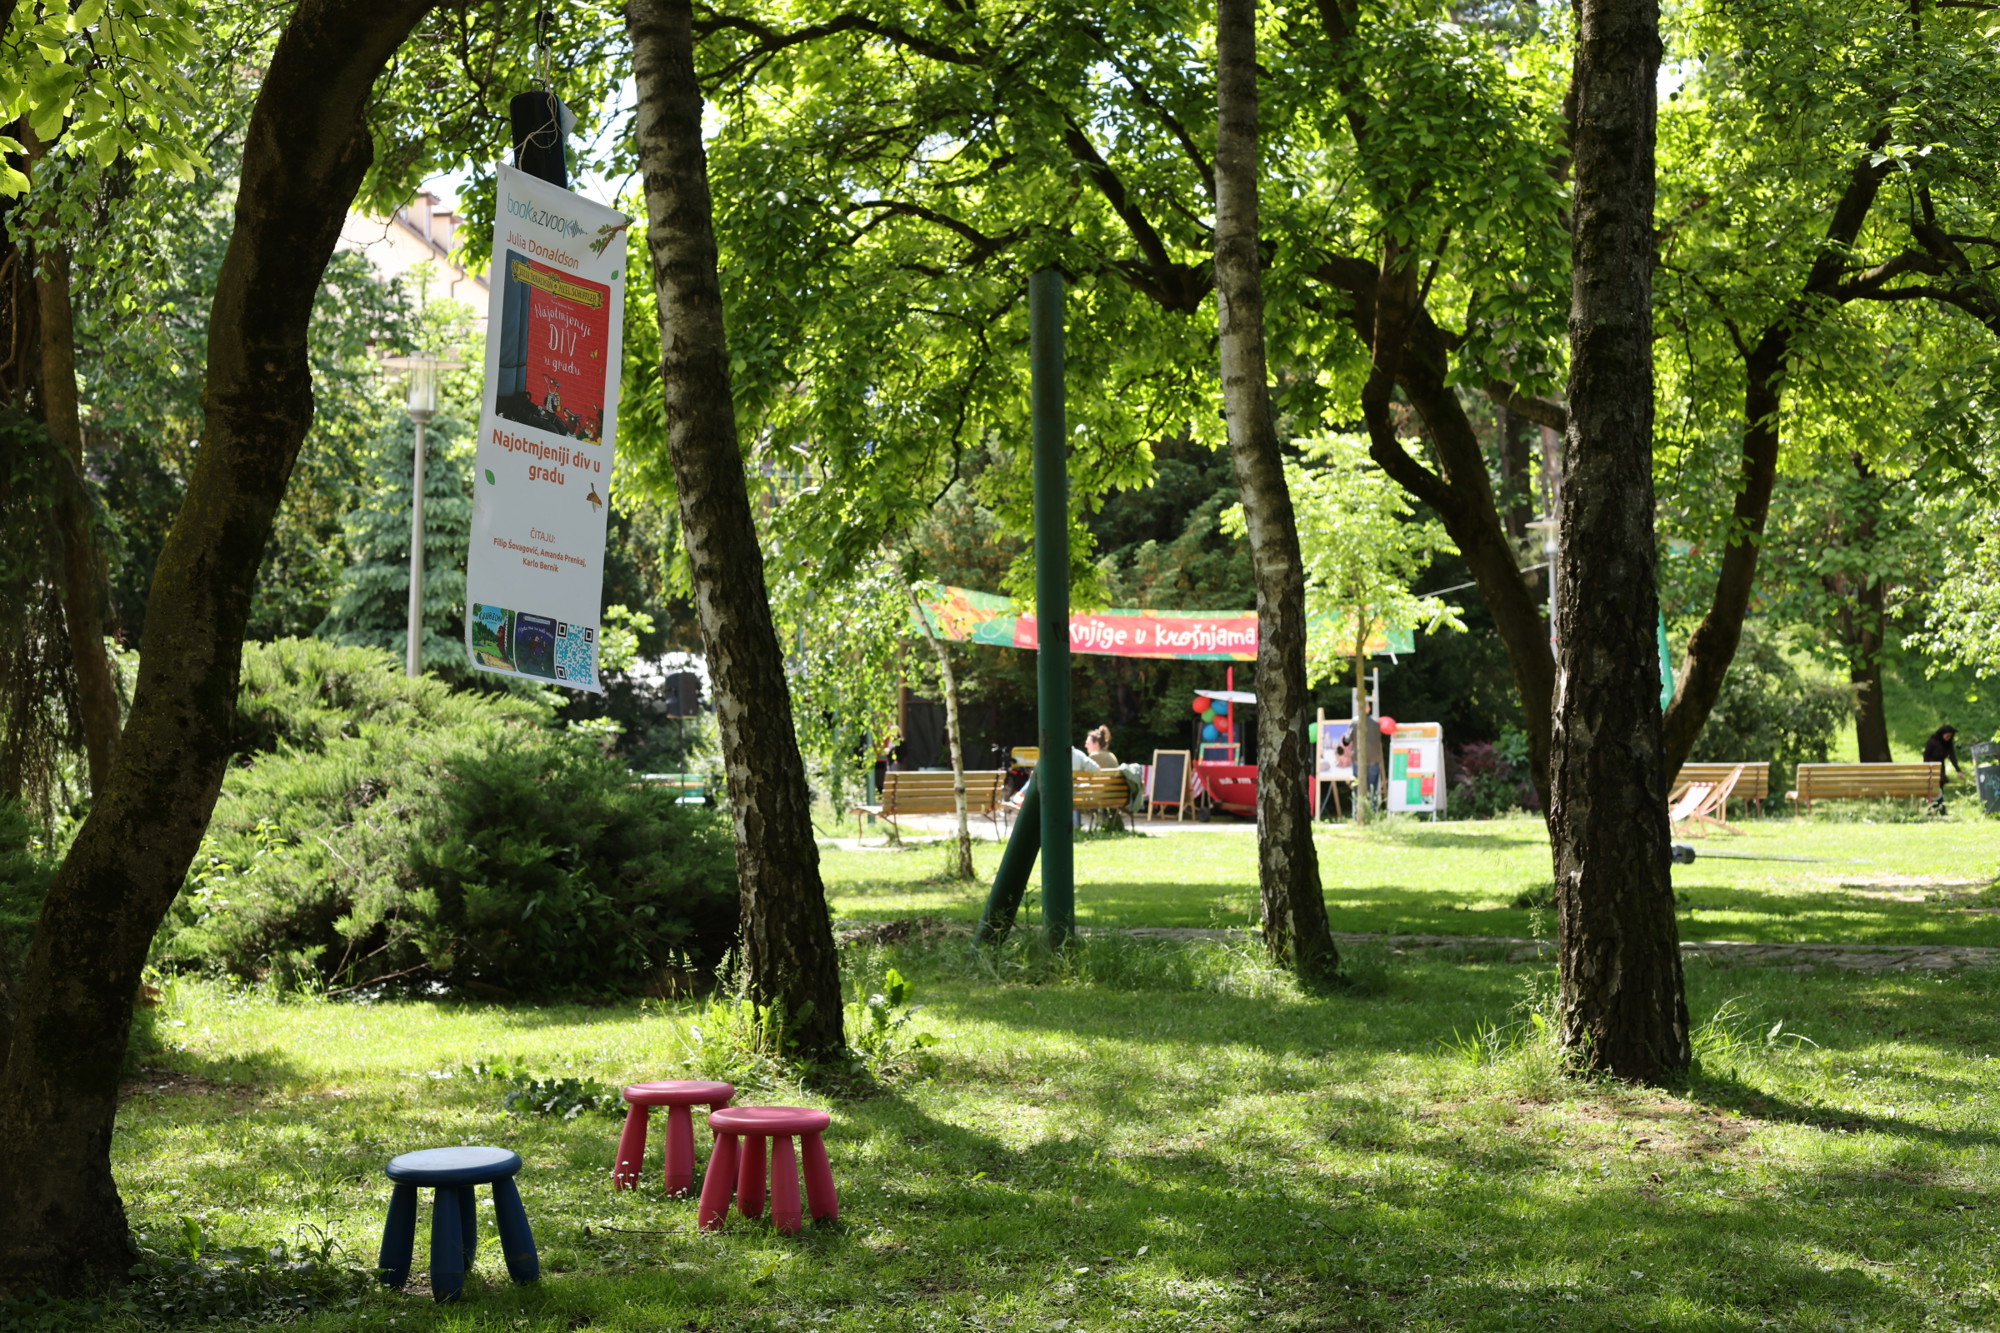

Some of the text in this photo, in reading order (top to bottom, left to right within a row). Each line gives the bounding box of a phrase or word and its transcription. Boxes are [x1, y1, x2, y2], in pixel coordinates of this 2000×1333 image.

[506, 230, 579, 270] Julia Donaldson
[534, 303, 591, 337] Najotmjeniji
[549, 324, 577, 357] DIV
[552, 358, 581, 376] gradu
[492, 429, 601, 473] Najotmjeniji div u
[528, 465, 565, 485] gradu
[530, 527, 556, 544] ČITAJU:
[493, 537, 508, 549] Filip
[540, 549, 564, 561] Amanda
[565, 554, 587, 568] Prenkaj,
[522, 558, 559, 573] Karlo Bernik
[1069, 619, 1256, 651] Knjige u krošnjama
